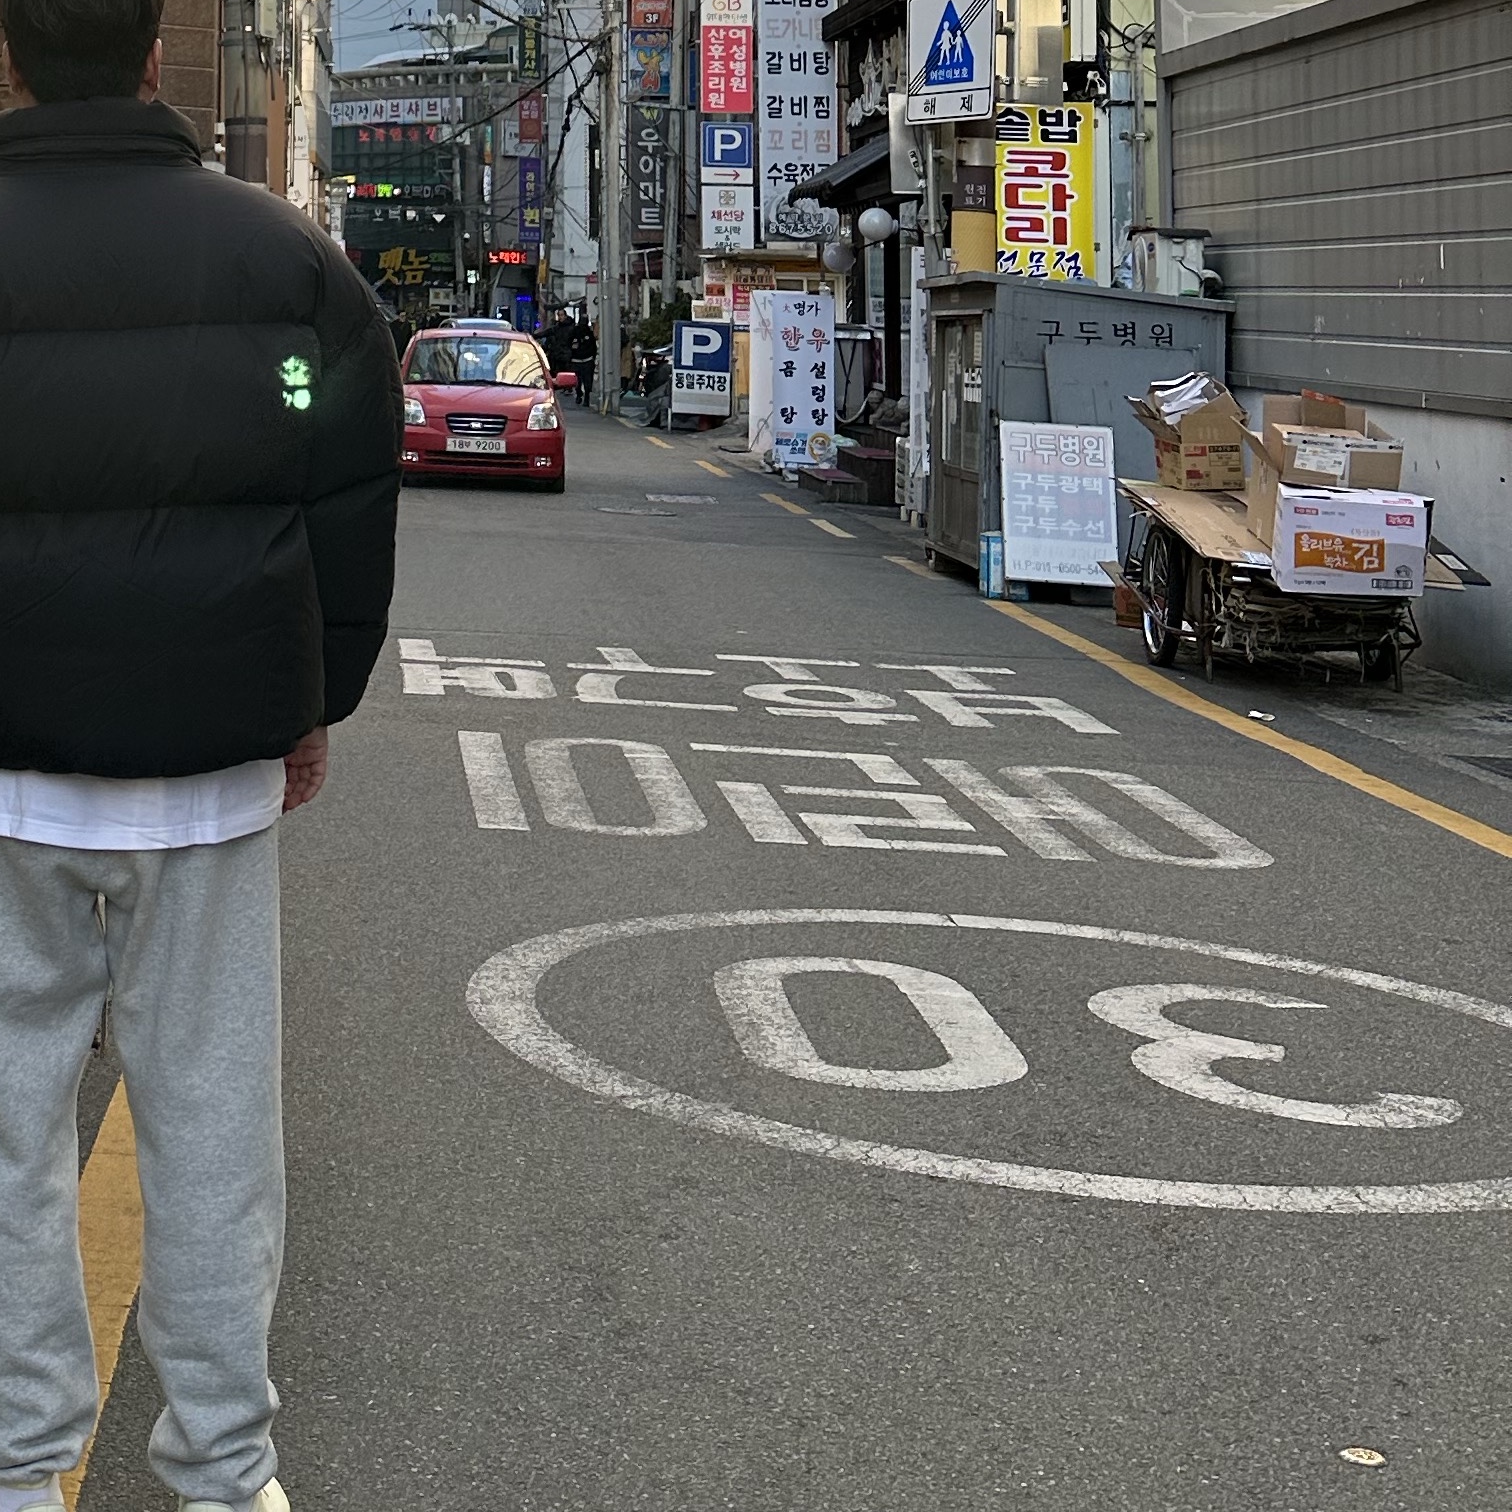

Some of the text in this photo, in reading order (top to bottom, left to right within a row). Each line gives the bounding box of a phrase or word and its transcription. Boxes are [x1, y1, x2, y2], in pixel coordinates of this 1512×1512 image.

[645, 13, 659, 23] 3F
[707, 29, 727, 109] 산후조리원
[728, 29, 748, 93] 여성병원
[766, 51, 831, 75] 갈비탕
[930, 68, 969, 81] 어린이보호
[766, 95, 830, 119] 갈비찜
[995, 107, 1082, 144] 솥밥
[714, 129, 742, 161] P
[637, 128, 665, 229] 우아마트
[1003, 150, 1075, 245] 코다리
[711, 210, 744, 222] 채선당
[714, 226, 741, 235] 도시락
[794, 300, 820, 316] 명가
[1036, 320, 1174, 347] 구두병원
[681, 326, 723, 367] P
[675, 372, 727, 392] 동일주차장
[475, 441, 501, 451] 9200
[1010, 432, 1106, 468] 구두병원
[1012, 472, 1104, 495] 구두광택
[1012, 494, 1059, 514] 구두
[1014, 516, 1105, 538] 구두수선
[1300, 534, 1345, 552] 올리브유
[1352, 542, 1379, 570] 김
[397, 637, 1122, 736] 보호구역
[455, 728, 1277, 872] 어린이
[712, 954, 1466, 1130] 30
